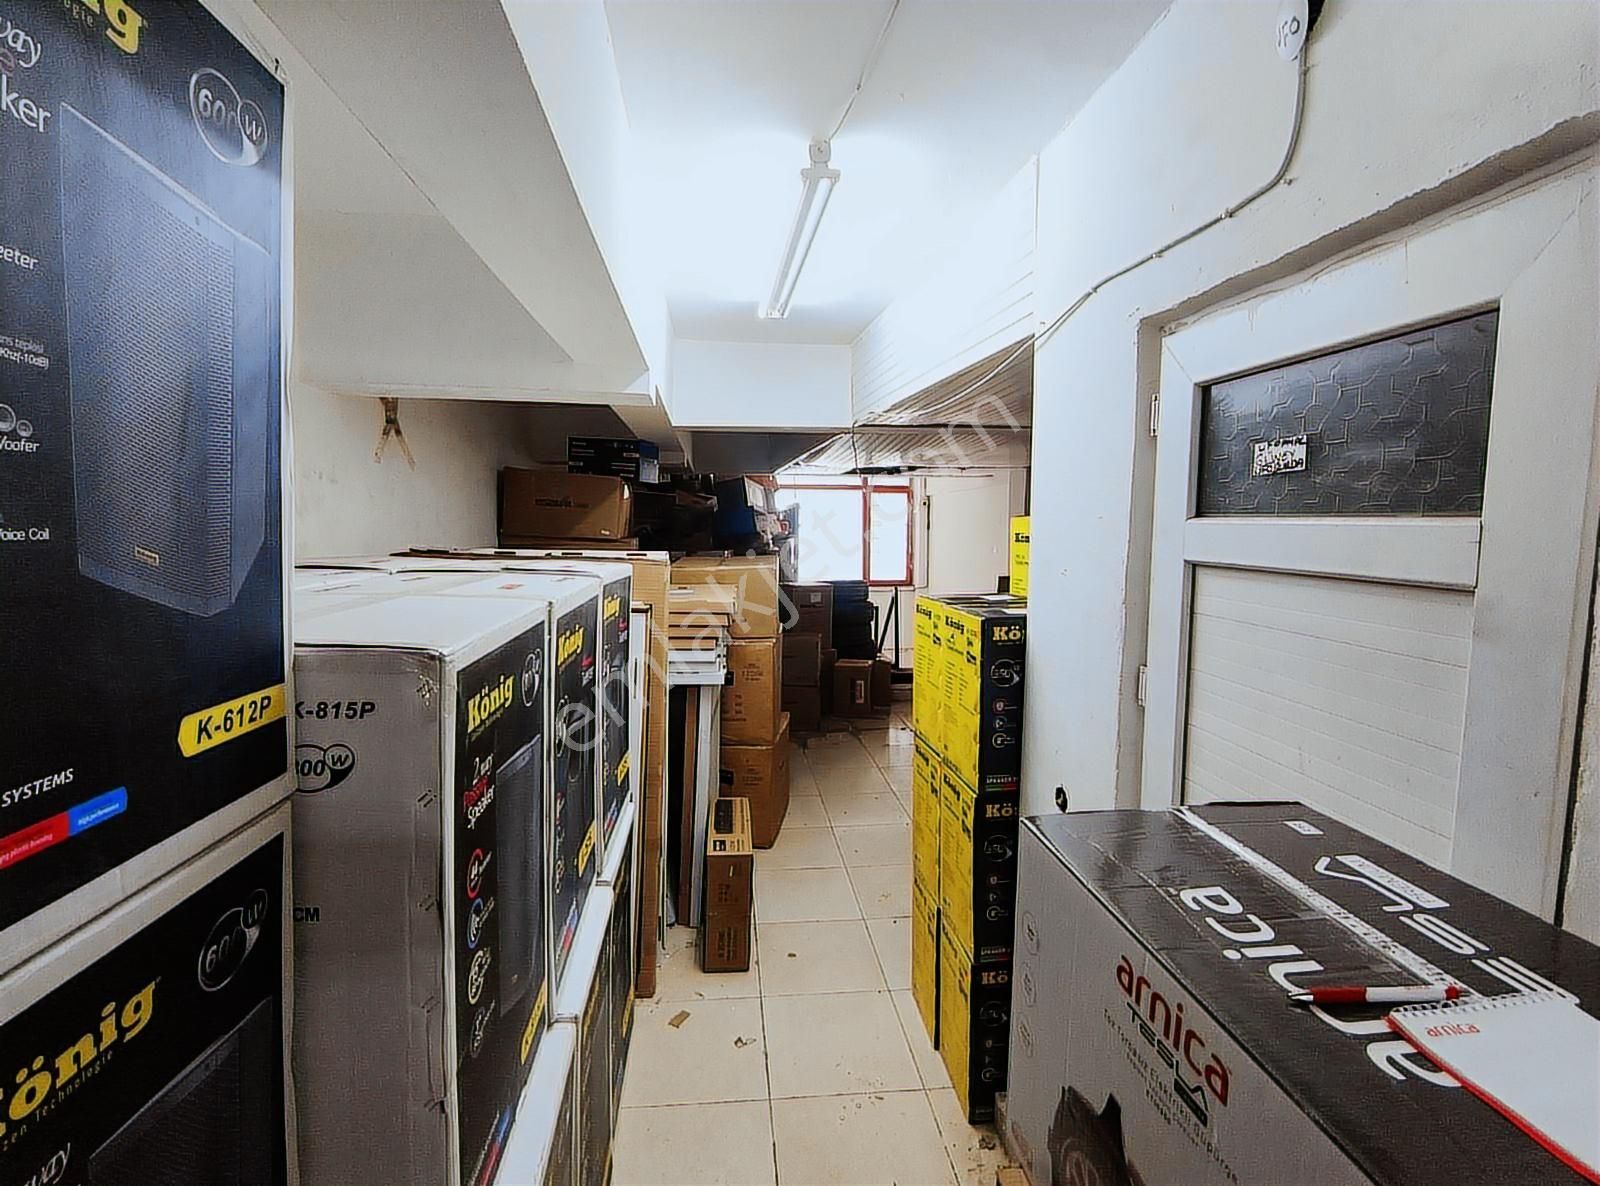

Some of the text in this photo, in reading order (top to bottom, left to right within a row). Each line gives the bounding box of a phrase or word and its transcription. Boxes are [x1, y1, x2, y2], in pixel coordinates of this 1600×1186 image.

[196, 695, 272, 744] K-612P
[468, 675, 514, 733] König
[2, 768, 75, 807] SYSTEMS
[295, 759, 325, 777] 00
[0, 981, 155, 1136] önig
[1116, 954, 1230, 1107] arnica
[1126, 1001, 1209, 1113] TESLA
